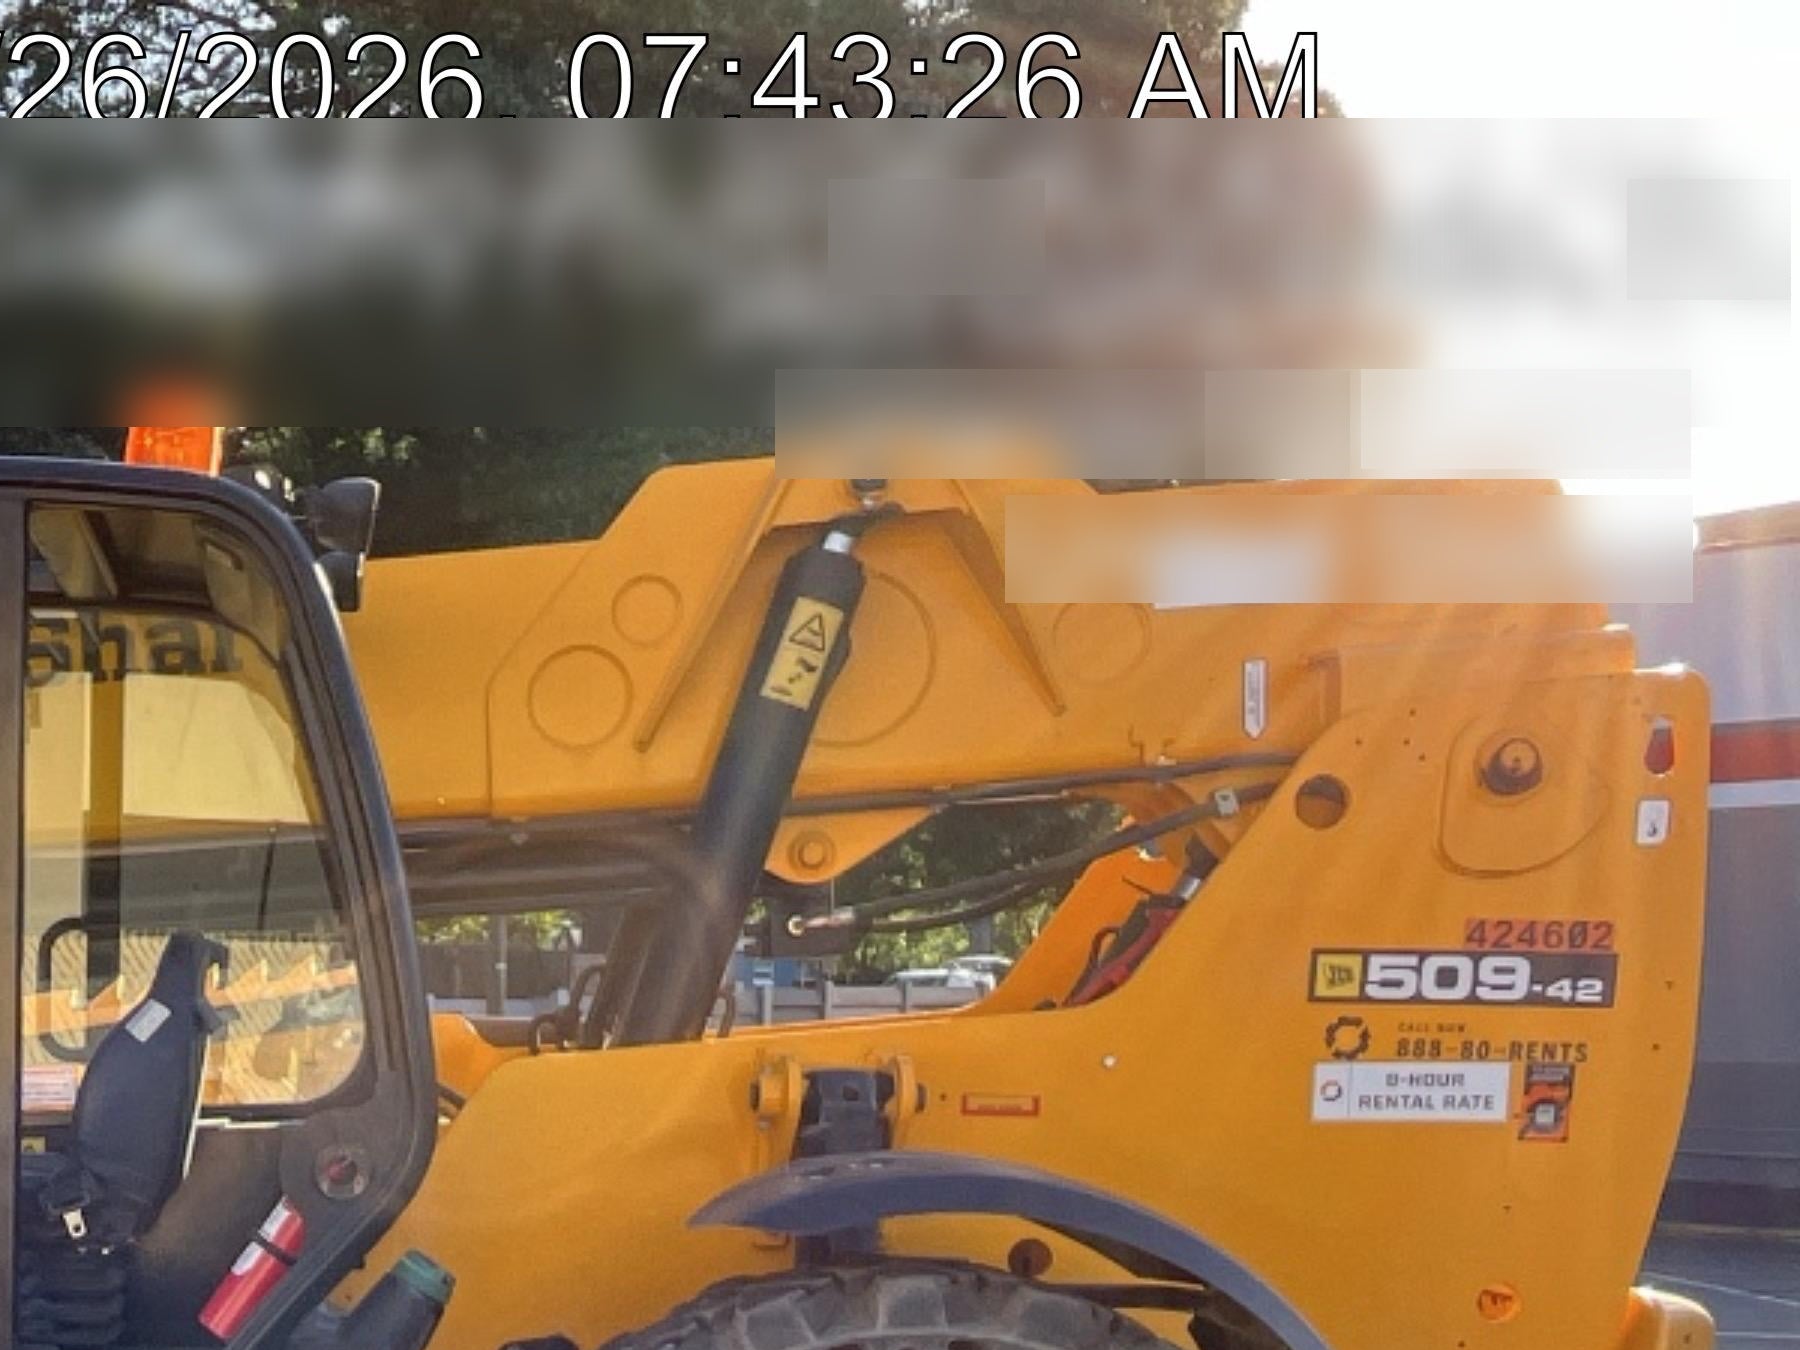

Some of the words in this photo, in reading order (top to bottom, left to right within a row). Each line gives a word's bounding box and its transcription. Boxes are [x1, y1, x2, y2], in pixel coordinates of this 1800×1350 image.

[1464, 918, 1615, 949] 424602
[1396, 1037, 1588, 1063] 888-80-RENTS
[1358, 1094, 1435, 1111] RENTAL
[1442, 1094, 1495, 1111] RATE
